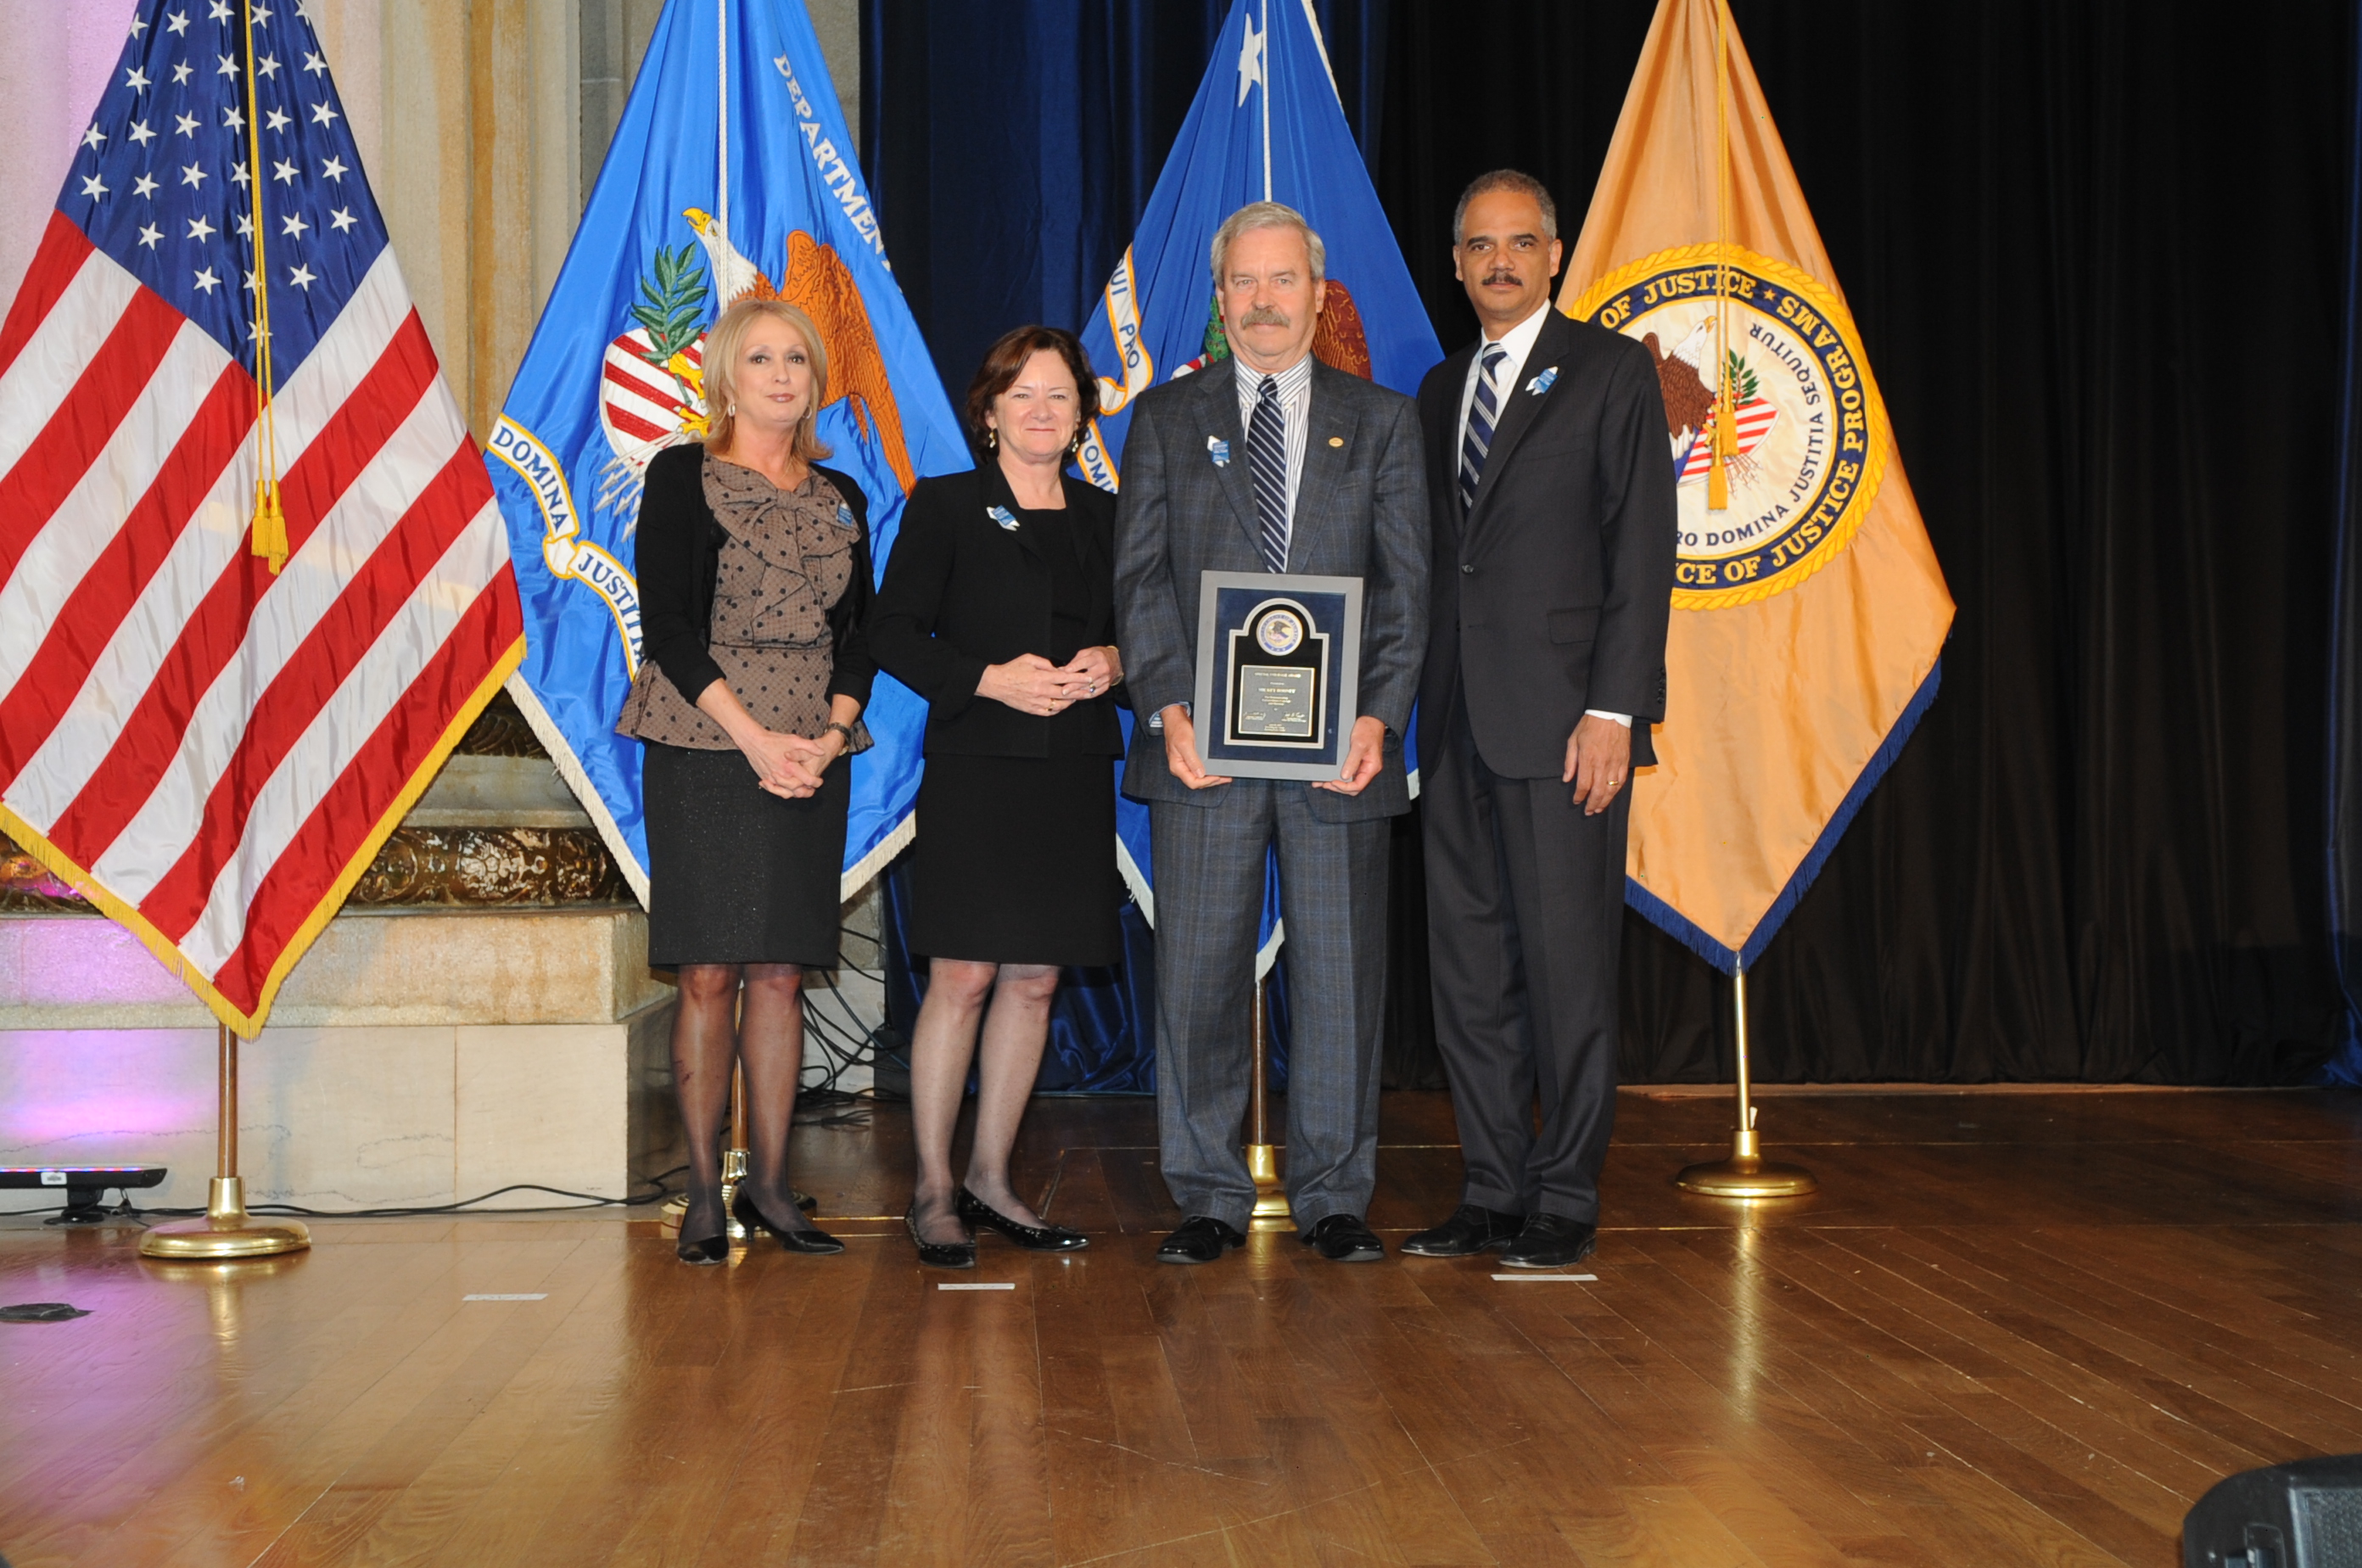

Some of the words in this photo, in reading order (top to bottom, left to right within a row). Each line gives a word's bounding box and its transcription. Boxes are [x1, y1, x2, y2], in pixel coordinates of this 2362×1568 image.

[774, 53, 891, 272] DEPARTMEN
[1600, 295, 1632, 329] OF
[1643, 270, 1756, 305] JUSTICE
[1749, 322, 1821, 406] SEQUITUR
[1777, 295, 1864, 452] PROGRAMS
[493, 426, 568, 533] DOMINA
[1788, 412, 1823, 503] JUSTITIA
[1706, 504, 1790, 546] DOMINA
[1771, 460, 1860, 567] JUSTICE
[1724, 556, 1760, 581] OF
